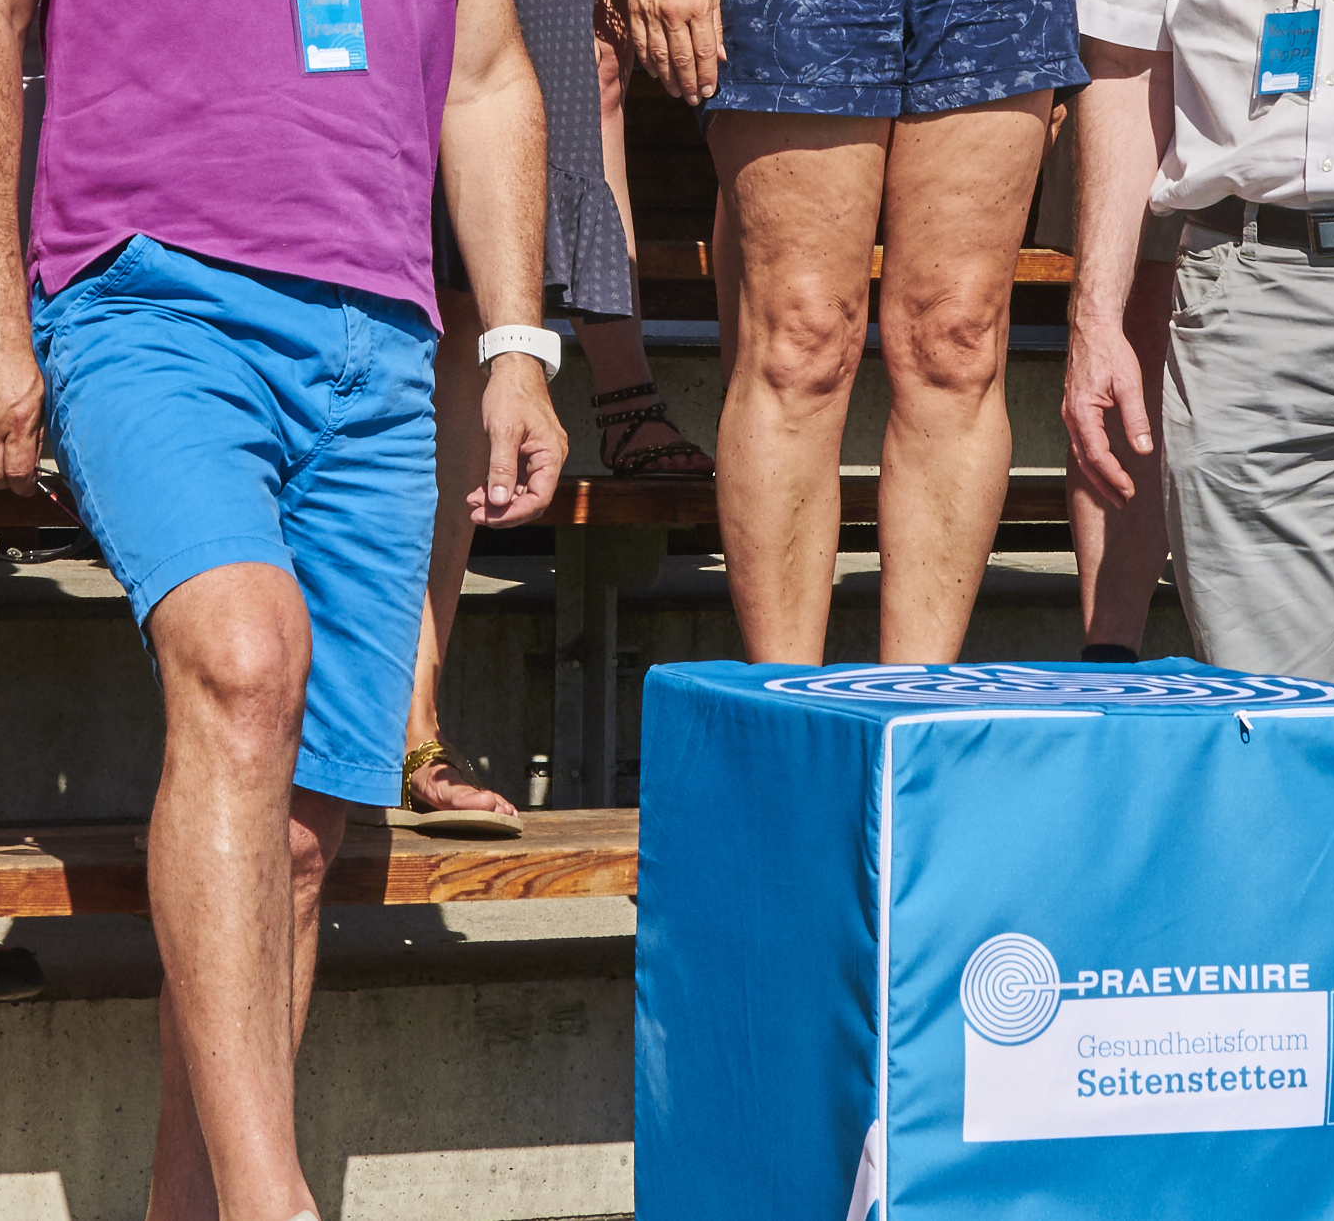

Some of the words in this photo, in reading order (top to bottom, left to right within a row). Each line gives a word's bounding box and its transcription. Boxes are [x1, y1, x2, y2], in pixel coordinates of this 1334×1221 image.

[1269, 47, 1311, 65] POPP
[1077, 963, 1311, 996] PRAEVENIRE
[1077, 1027, 1310, 1060] Gesundheitsforum
[1076, 1065, 1309, 1099] Seitenstetten
